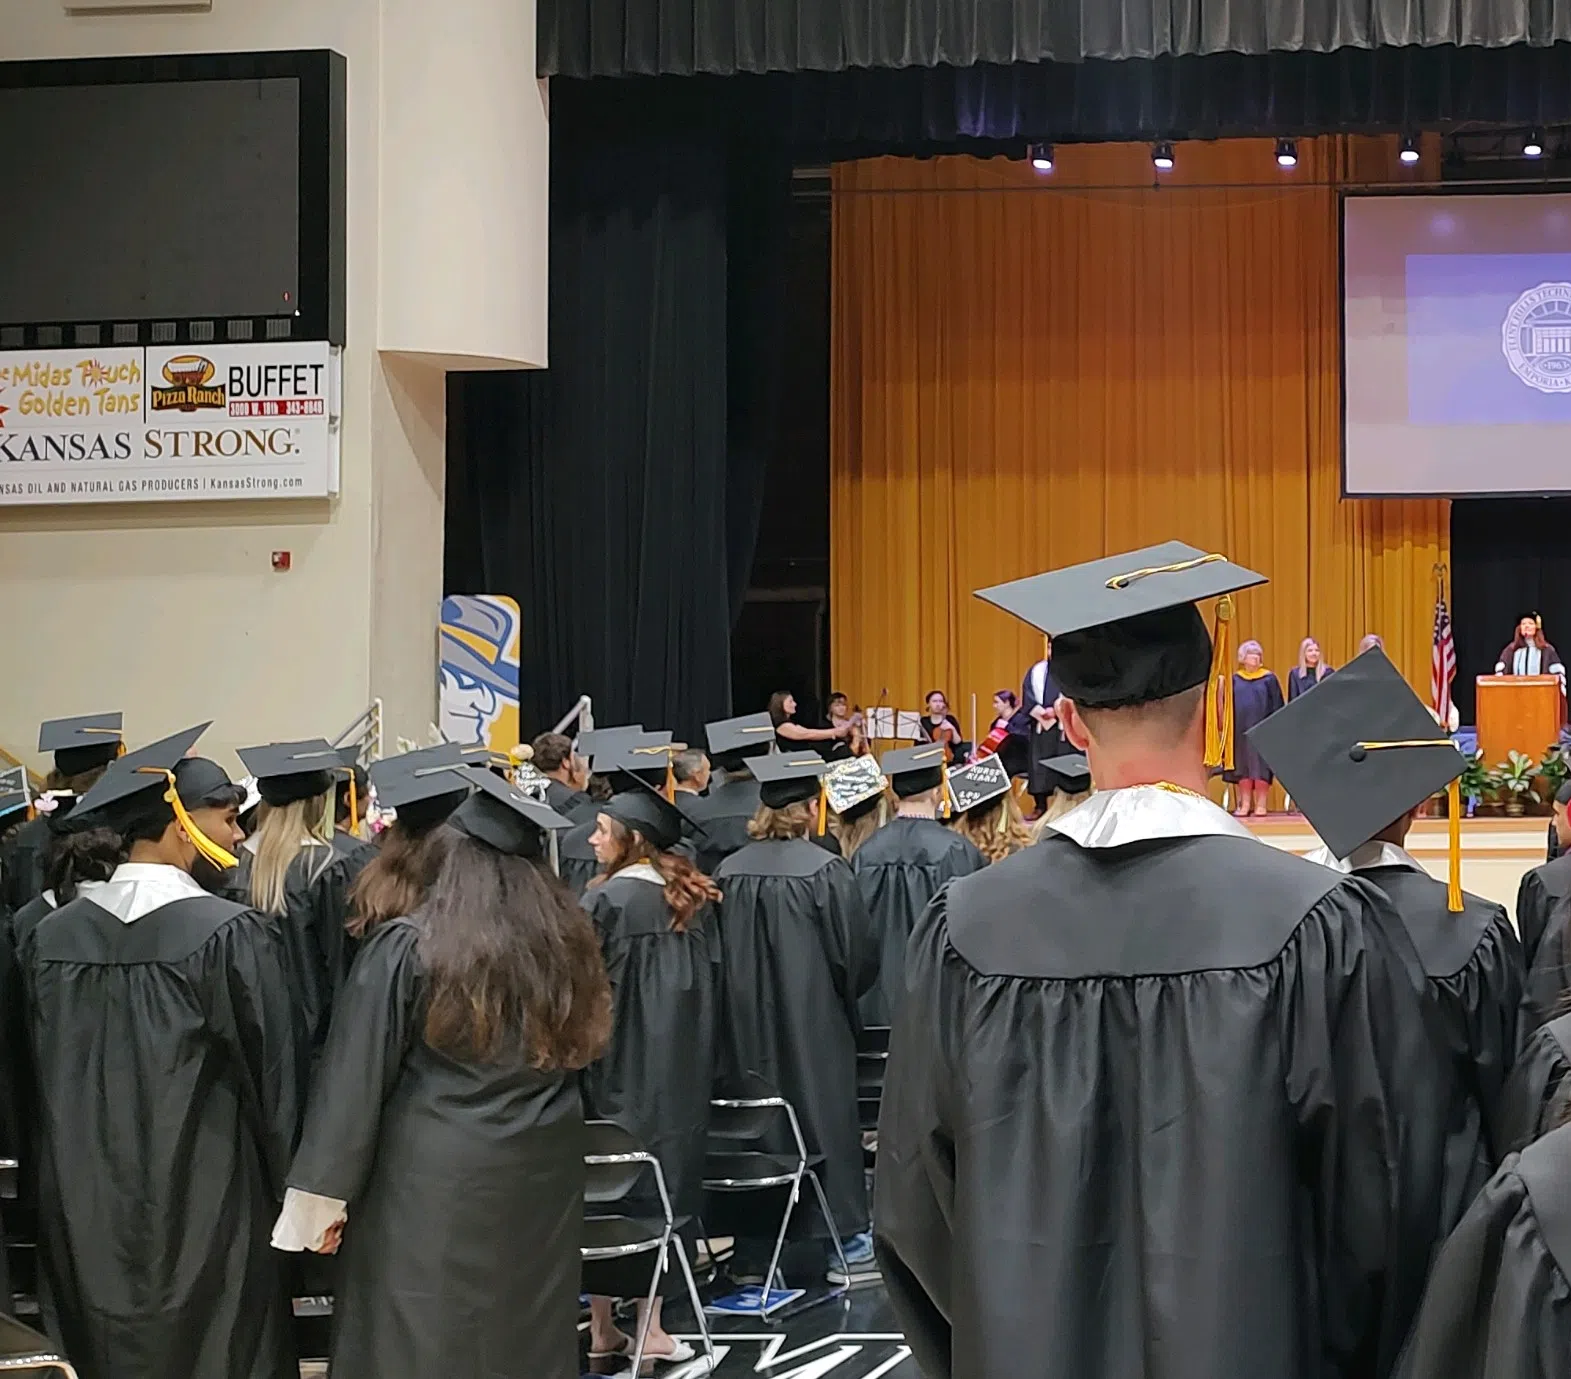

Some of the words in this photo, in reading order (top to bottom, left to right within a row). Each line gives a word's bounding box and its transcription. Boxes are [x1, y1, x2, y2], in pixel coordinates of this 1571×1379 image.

[12, 361, 72, 389] Midas
[229, 364, 324, 397] BUFFET
[18, 388, 91, 417] Golden
[93, 387, 140, 416] Tans
[152, 389, 186, 408] Pizza
[187, 385, 225, 405] Ranch
[0, 432, 132, 462] KANSAS
[27, 482, 43, 494] OIL
[47, 481, 66, 493] AND
[71, 480, 114, 492] NATURAL
[118, 480, 138, 492] GAS
[141, 478, 199, 491] PRODUCERS
[210, 476, 303, 490] KansasStrong.com
